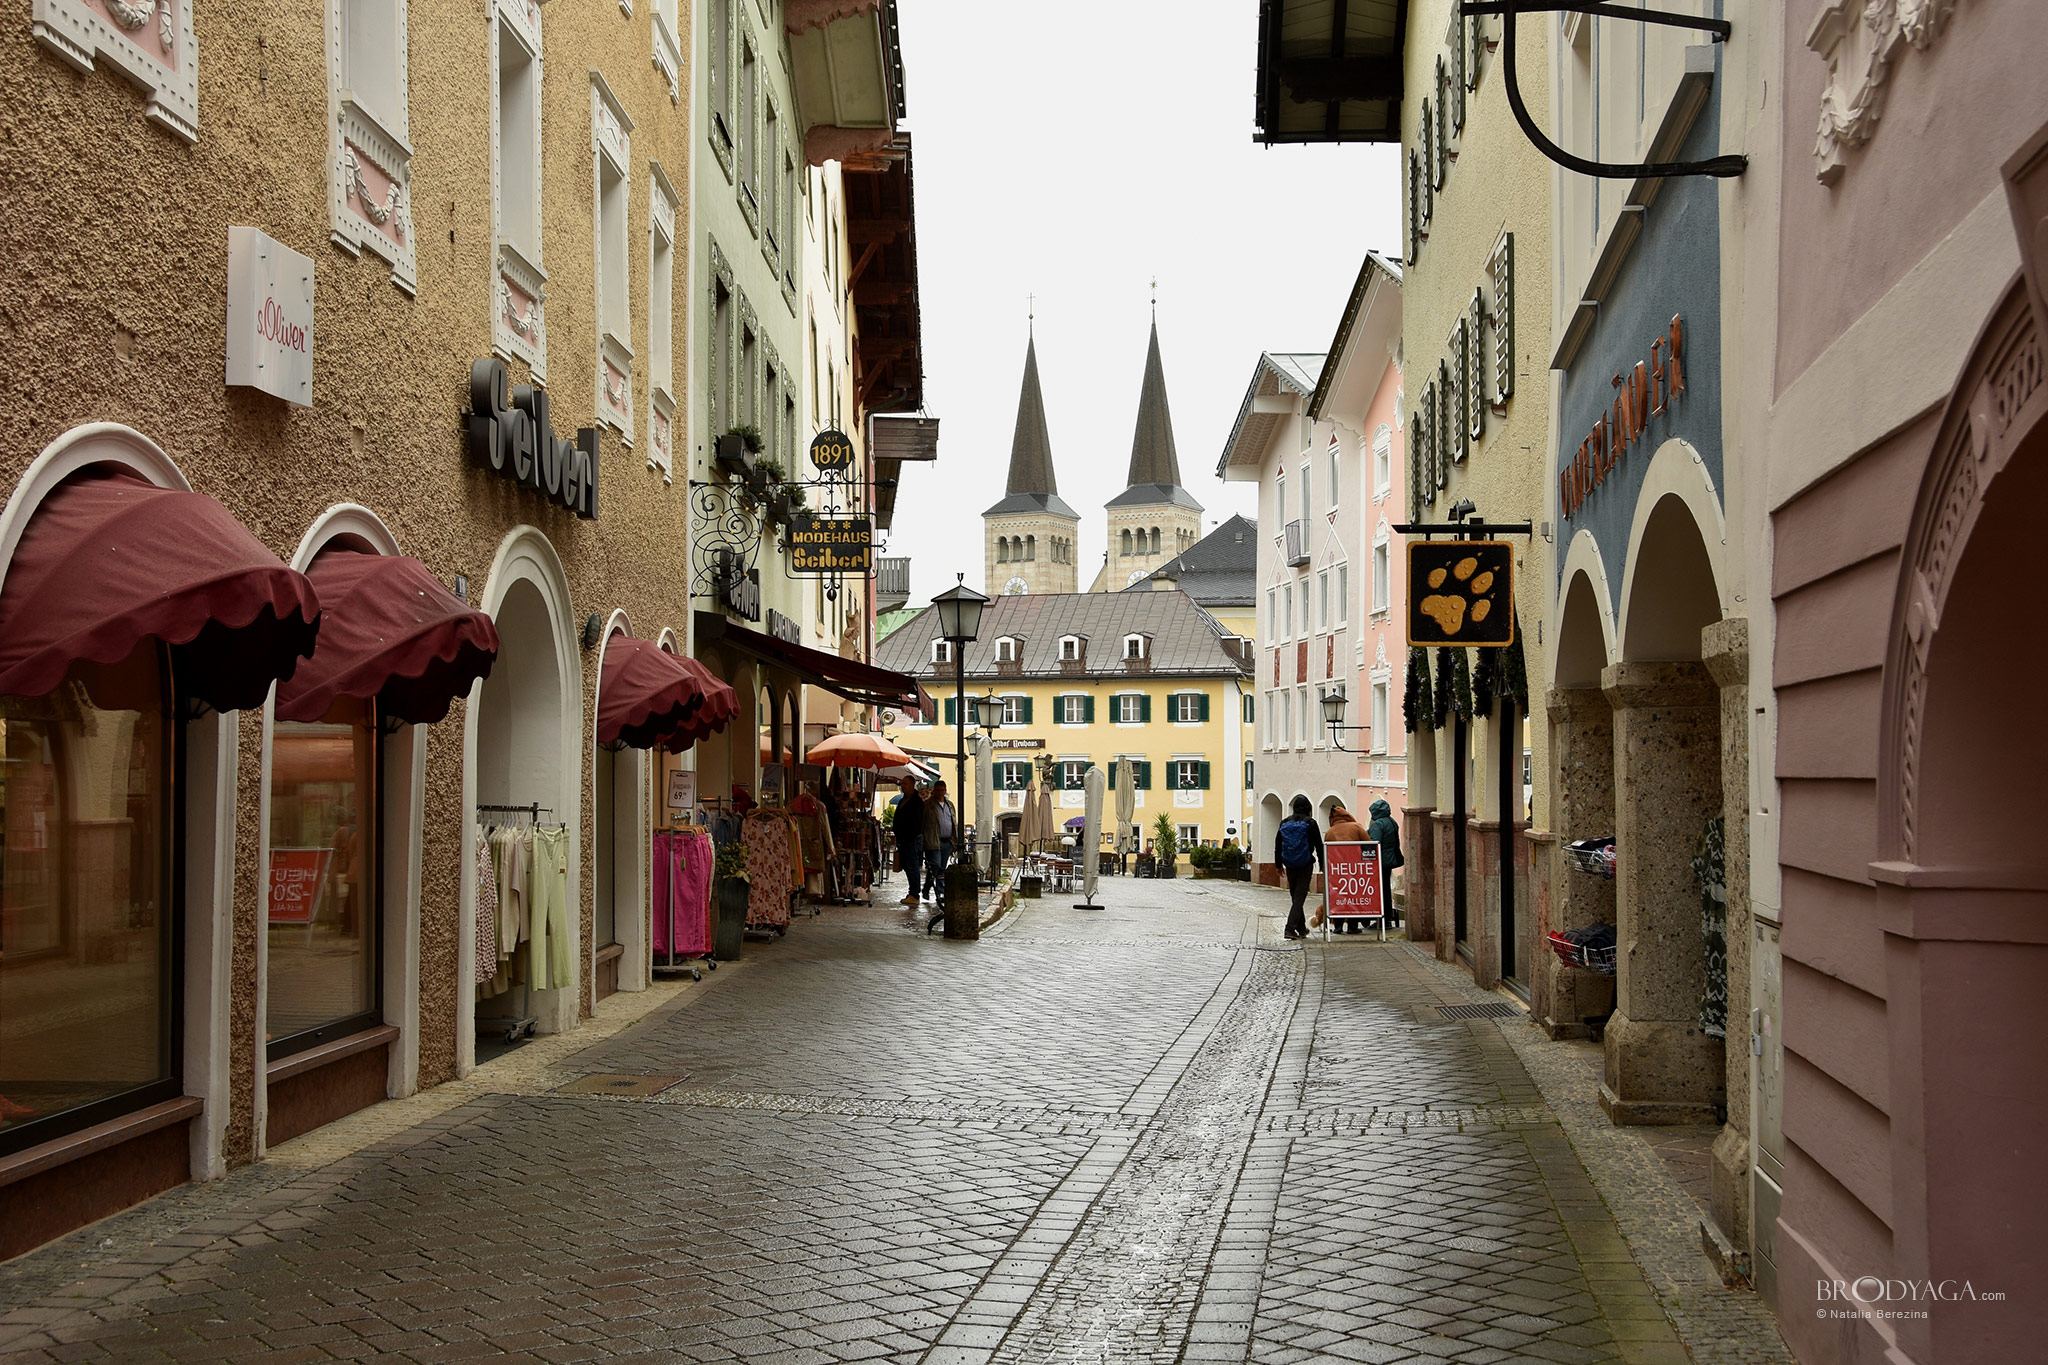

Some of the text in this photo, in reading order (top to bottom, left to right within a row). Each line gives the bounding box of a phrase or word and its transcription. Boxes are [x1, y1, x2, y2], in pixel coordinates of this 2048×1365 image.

[470, 358, 599, 520] Seiberl
[811, 444, 851, 465] 1891
[793, 531, 870, 543] MODEHAUS
[793, 547, 870, 568] Seiberl
[1331, 862, 1374, 875] HEUTE
[1332, 877, 1374, 896] -20%
[1347, 897, 1371, 905] ALLES!
